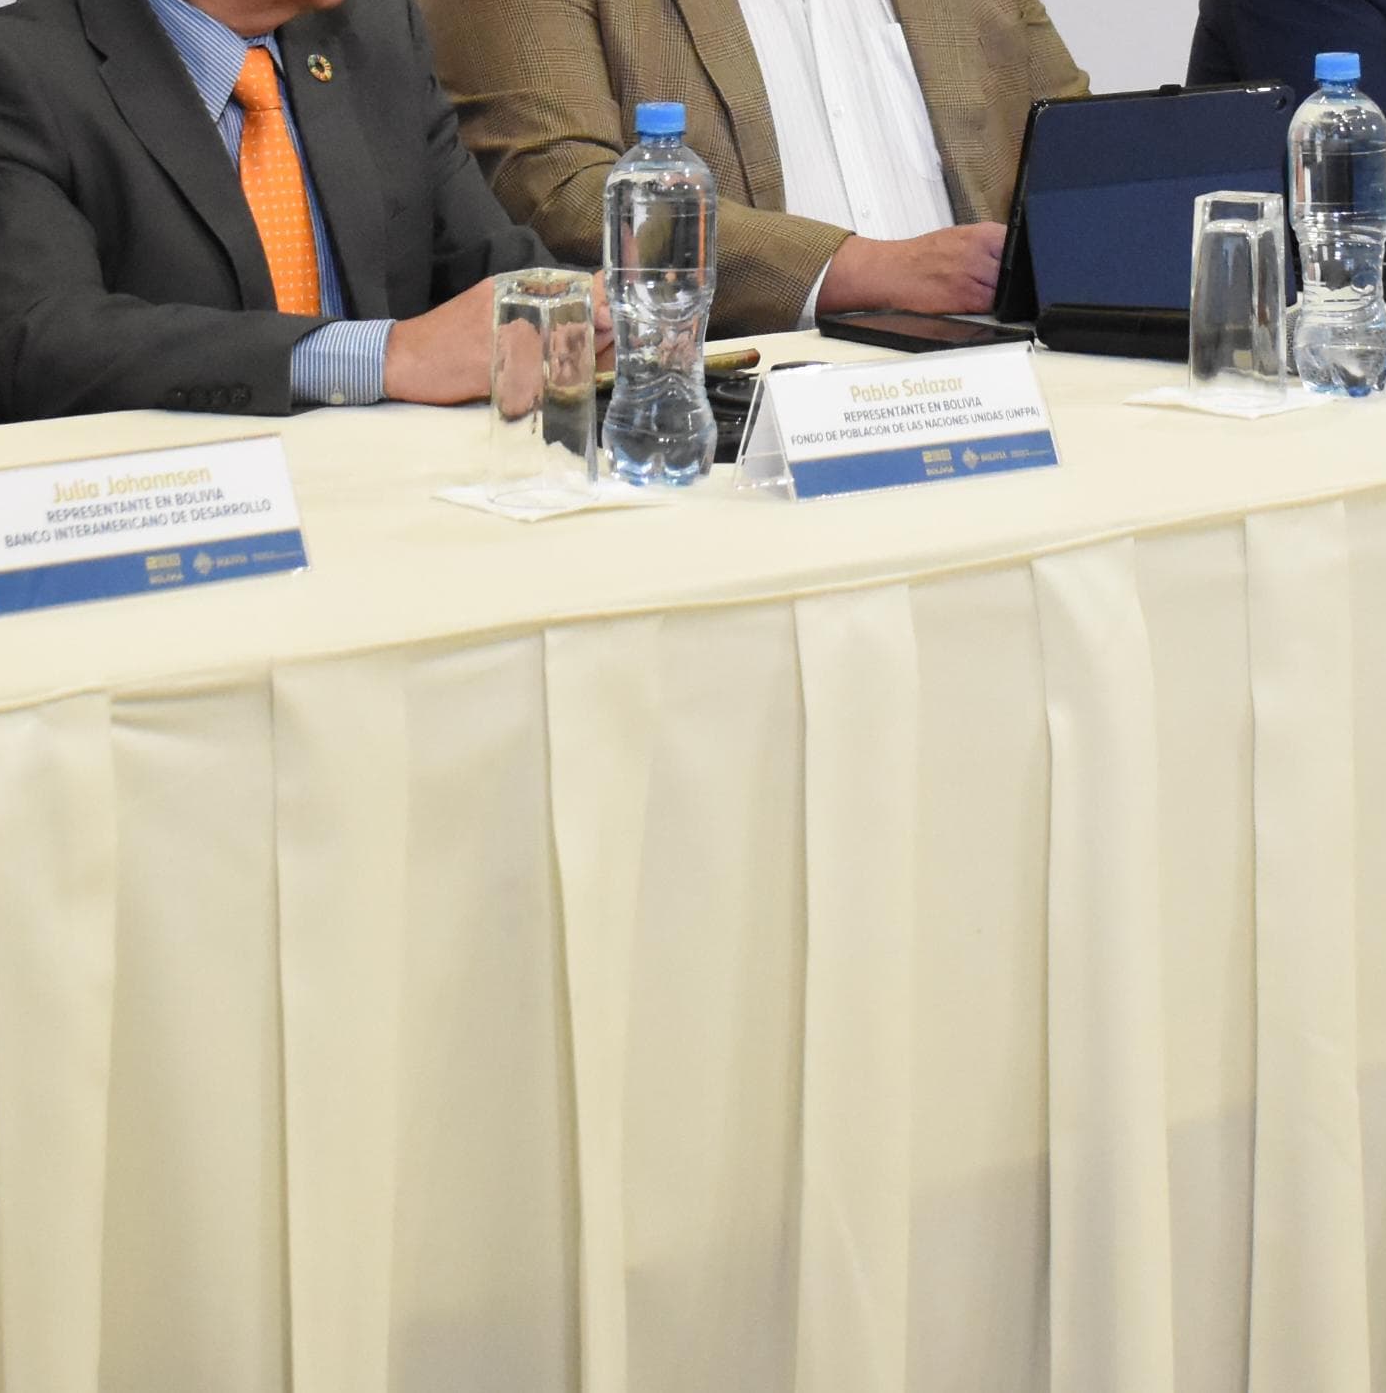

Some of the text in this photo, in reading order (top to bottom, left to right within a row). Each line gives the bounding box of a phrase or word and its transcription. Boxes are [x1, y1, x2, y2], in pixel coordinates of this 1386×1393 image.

[850, 376, 963, 403] Pablo Salazar
[791, 431, 824, 446] FONDO
[826, 429, 838, 442] DE
[892, 422, 905, 434] DE
[907, 419, 924, 431] LAS
[925, 414, 969, 430] NACIONES
[970, 410, 1004, 423] UNIDAS
[1006, 405, 1040, 421] (UNFPA)
[844, 396, 982, 423] REPRESENTANTE EN BOLIVIA
[53, 467, 212, 503] Julia Johannsen
[46, 488, 224, 523] REPRESENTANTE EN BOLIVIA
[5, 499, 271, 548] BANCO INTERAMERICANO DE DESARROLLO
